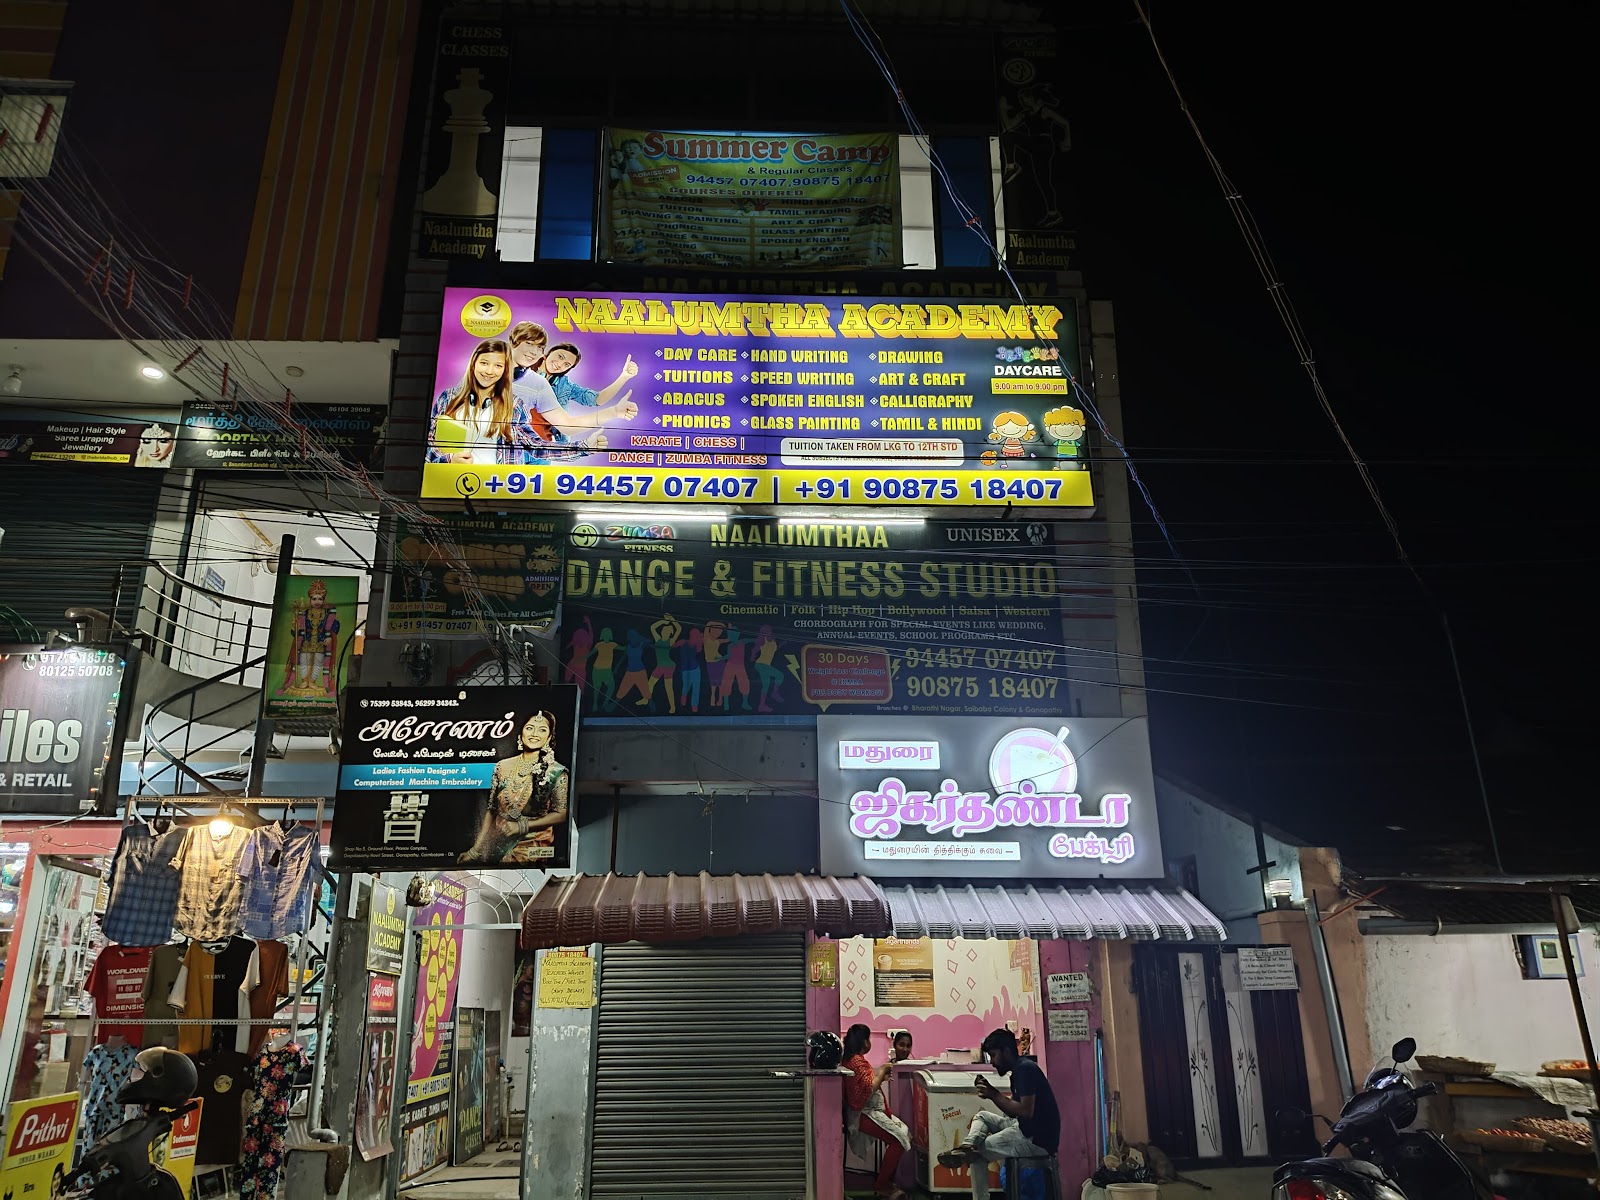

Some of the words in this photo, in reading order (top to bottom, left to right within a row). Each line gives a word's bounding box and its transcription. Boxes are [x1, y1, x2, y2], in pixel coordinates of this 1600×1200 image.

[451, 25, 503, 39] CHESS
[440, 43, 510, 58] CLASSES
[643, 132, 788, 161] Summer
[793, 139, 890, 165] Camp
[632, 166, 678, 179] ADMISSION
[747, 167, 756, 175] &
[760, 167, 803, 176] Regular
[808, 165, 853, 175] Classes
[686, 174, 734, 185] 94457
[739, 176, 840, 187] 07407,90875
[845, 172, 891, 185] 18407
[669, 186, 737, 196] COURSES
[620, 208, 671, 219] DRAWING
[658, 204, 703, 212] TUITION
[804, 207, 851, 216] READING
[657, 223, 704, 231] PHONICS
[808, 217, 845, 225] CRAFT
[423, 220, 494, 238] Naalumtha
[651, 231, 688, 240] DANCE
[703, 235, 747, 243] SINGING
[1009, 234, 1077, 249] Naalumtha
[429, 238, 487, 258] Academy
[657, 240, 697, 249] BOXING
[1016, 251, 1070, 269] Academy
[553, 297, 836, 338] NAALUMTHA
[838, 303, 1063, 339] ACADEMY
[664, 347, 693, 361] DAY
[697, 348, 738, 362] CARE
[751, 350, 787, 363] HAND
[791, 350, 849, 364] WRITING
[878, 351, 943, 363] DRAWING
[663, 370, 733, 384] TUITIONS
[994, 365, 1062, 376] DAYCARE
[751, 371, 793, 385] SPEED
[797, 372, 855, 386] WRITING
[879, 372, 907, 386] ART
[908, 372, 919, 386] &
[922, 373, 966, 386] CRAFT
[1053, 384, 1065, 392] pm
[662, 392, 725, 406] ABACUS
[750, 393, 803, 408] SPOKEN
[808, 394, 865, 408] ENGLISH
[879, 395, 974, 409] CALLIGRAPHY
[662, 414, 731, 429] PHONICS
[750, 416, 794, 430] GLASS
[799, 417, 860, 431] PAINTING
[880, 417, 924, 431] TAMIL
[928, 418, 938, 431] &
[942, 417, 982, 431] HINDI
[47, 424, 80, 435] Makeup
[86, 426, 104, 434] Hair
[105, 426, 127, 436] Style
[55, 434, 80, 442] Saree
[631, 435, 683, 447] KARATE
[693, 437, 737, 448] CHESS
[62, 443, 103, 453] Jewellery
[789, 442, 825, 451] TUITION
[826, 442, 854, 451] TAKEN
[857, 442, 881, 451] FROM
[884, 442, 901, 451] LKG
[904, 442, 916, 451] TO
[918, 442, 939, 451] 12TH
[941, 442, 958, 451] STD
[609, 452, 654, 464] DANCE
[666, 453, 711, 465] ZUMBA
[715, 454, 768, 466] FITNESS
[485, 473, 544, 494] +91
[557, 474, 655, 496] 94457
[664, 475, 759, 498] 07407
[795, 478, 851, 499] +91
[863, 478, 959, 499] 90875
[970, 478, 1063, 500] 18407
[605, 525, 675, 542] ZUMBA
[710, 523, 889, 548] NAALUMTHAA
[946, 528, 1021, 542] UNISEX
[623, 544, 674, 554] FITNESS
[566, 559, 695, 597] DANCE
[710, 559, 737, 597] &
[752, 560, 906, 598] FITNESS
[919, 560, 1057, 599] STUDIO
[720, 603, 779, 615] Cinematic
[791, 604, 817, 615] Folk
[828, 604, 849, 617] Hip
[852, 604, 876, 617] Hop
[887, 604, 947, 618] Bollywood
[959, 606, 990, 616] Salsa
[1002, 606, 1051, 616] Western
[446, 621, 472, 630] 07407
[793, 619, 866, 629] CHOREOGRAPH
[869, 620, 889, 629] FOR
[890, 620, 932, 630] SPECIAL
[934, 620, 971, 629] EVENTS
[973, 621, 996, 629] LIKE
[998, 621, 1047, 631] WEDDING,
[816, 630, 855, 640] ANNUAL
[900, 631, 939, 640] SCHOOL
[941, 631, 994, 641] PROGRAMS
[818, 653, 833, 664] 30
[837, 653, 869, 666] Days
[906, 647, 978, 670] 94457
[984, 648, 1056, 670] 07407
[39, 666, 75, 677] 80125
[78, 666, 113, 677] 50708
[907, 676, 980, 697] 90875
[988, 677, 1058, 698] 18407
[911, 704, 939, 712] Bharathi
[965, 705, 997, 713] Saibaba
[1025, 706, 1063, 715] Ganapathy
[358, 711, 515, 745] அரோணம்
[844, 745, 934, 764] மதுரை
[372, 767, 396, 775] Ladies
[398, 767, 425, 775] Fashion
[427, 767, 459, 776] Designer
[12, 773, 72, 787] RETAIL
[354, 778, 405, 787] Computerised
[408, 778, 440, 786] Machine
[441, 778, 483, 787] Embroidery
[851, 778, 1131, 837] ஜிகர்தண்டா
[882, 844, 930, 857] மதுரையின்
[933, 844, 976, 857] தித்திக்கும்
[1052, 834, 1133, 862] பேக்டரி
[373, 911, 405, 935] NAALUMTHA
[374, 931, 402, 951] ACADEMY
[1051, 973, 1084, 983] WANTED
[942, 1109, 962, 1121] Special
[16, 1111, 70, 1150] Prithvi
[18, 1153, 37, 1165] INNER
[23, 1182, 35, 1193] Bra
